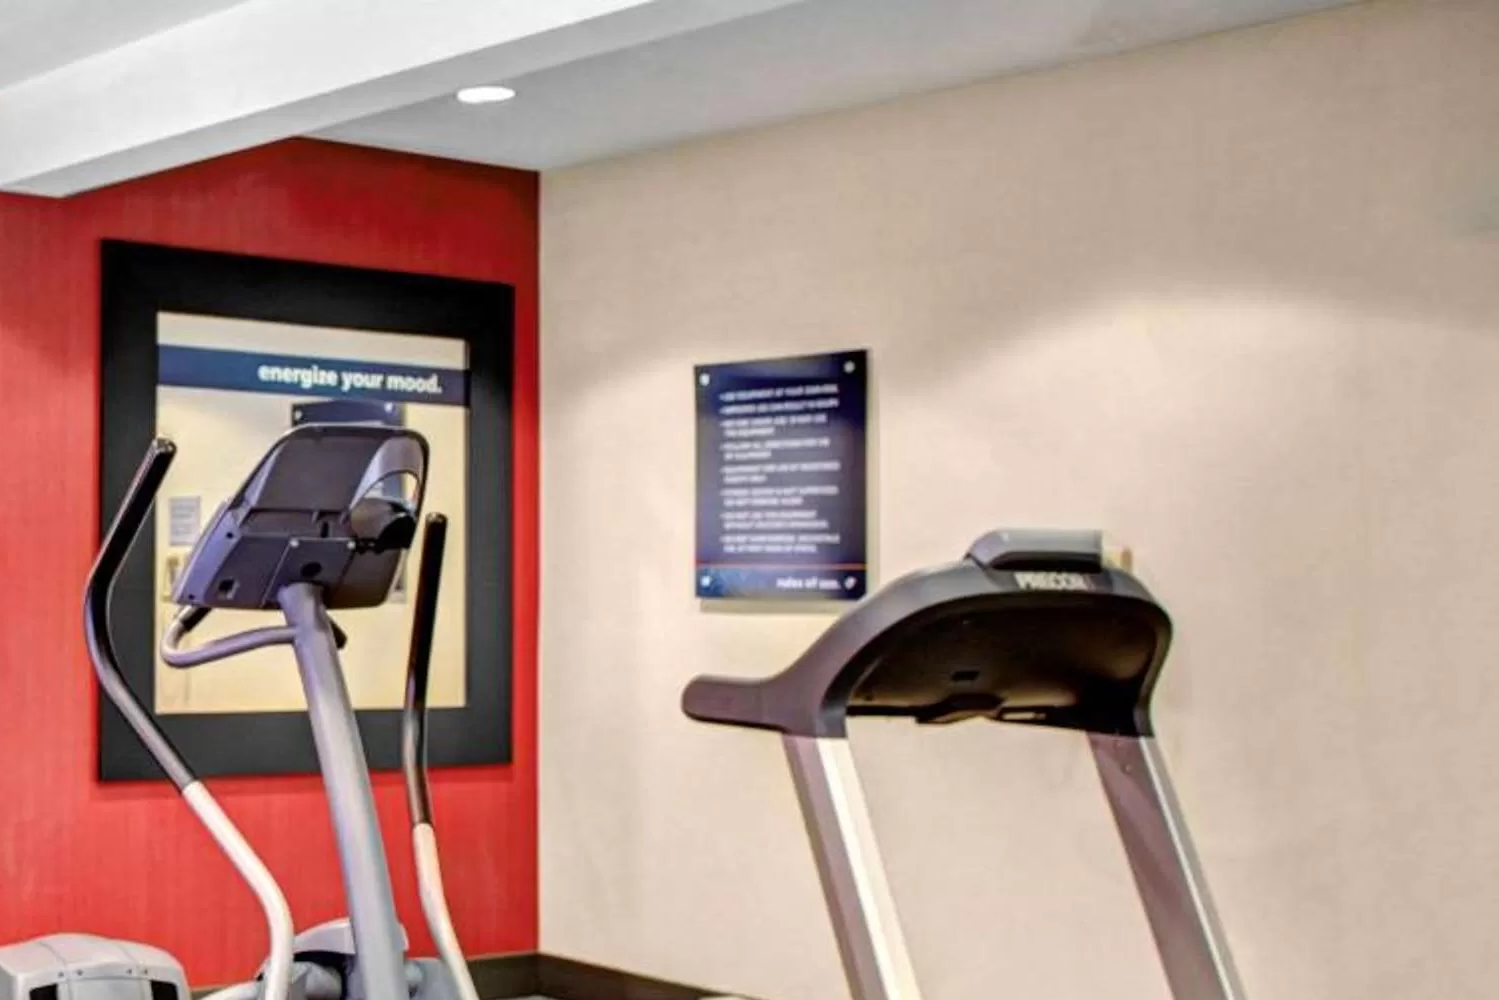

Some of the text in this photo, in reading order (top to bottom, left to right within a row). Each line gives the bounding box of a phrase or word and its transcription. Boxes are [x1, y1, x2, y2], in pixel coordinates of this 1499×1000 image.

[257, 364, 443, 394] energize your mood.
